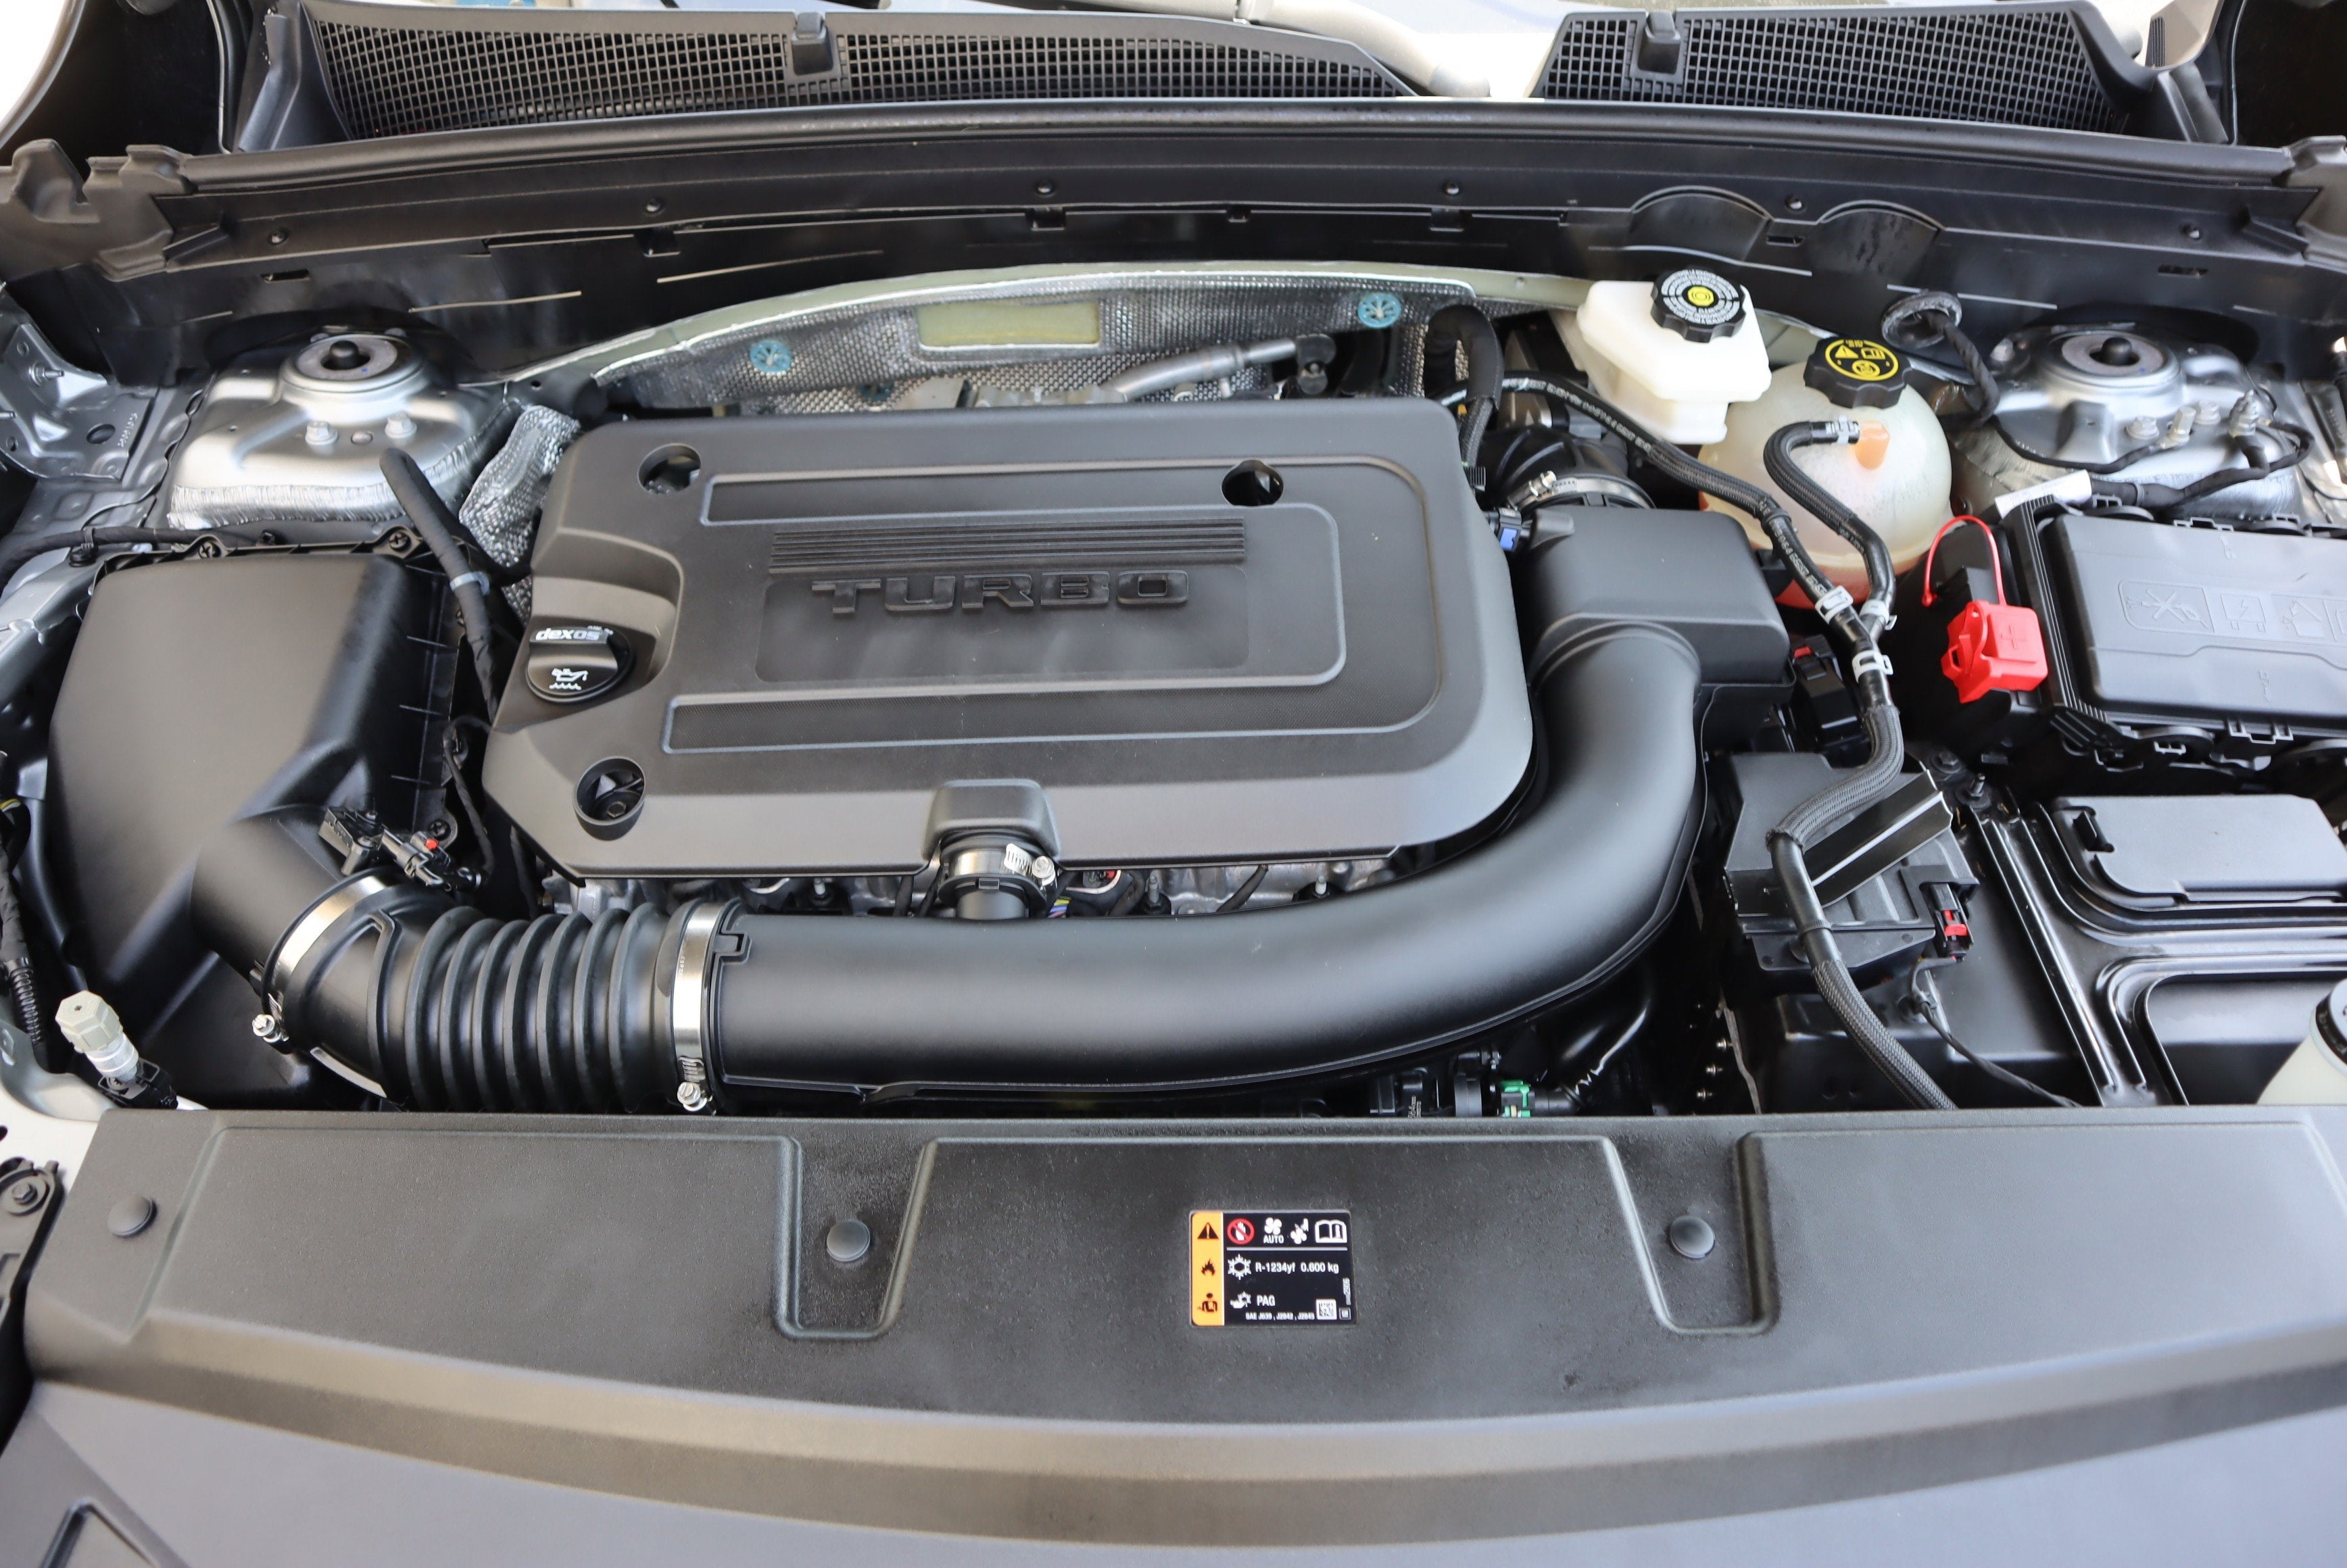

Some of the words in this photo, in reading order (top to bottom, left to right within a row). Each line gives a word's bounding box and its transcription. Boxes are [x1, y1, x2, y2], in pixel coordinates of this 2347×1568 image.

[811, 570, 1189, 614] TURBO
[535, 628, 600, 641] dexos
[1263, 1235, 1284, 1244] AUTO
[1255, 1262, 1295, 1274] R-1234yf
[1300, 1262, 1326, 1273] 0.600
[1328, 1262, 1339, 1274] kg
[1257, 1295, 1276, 1306] PAG
